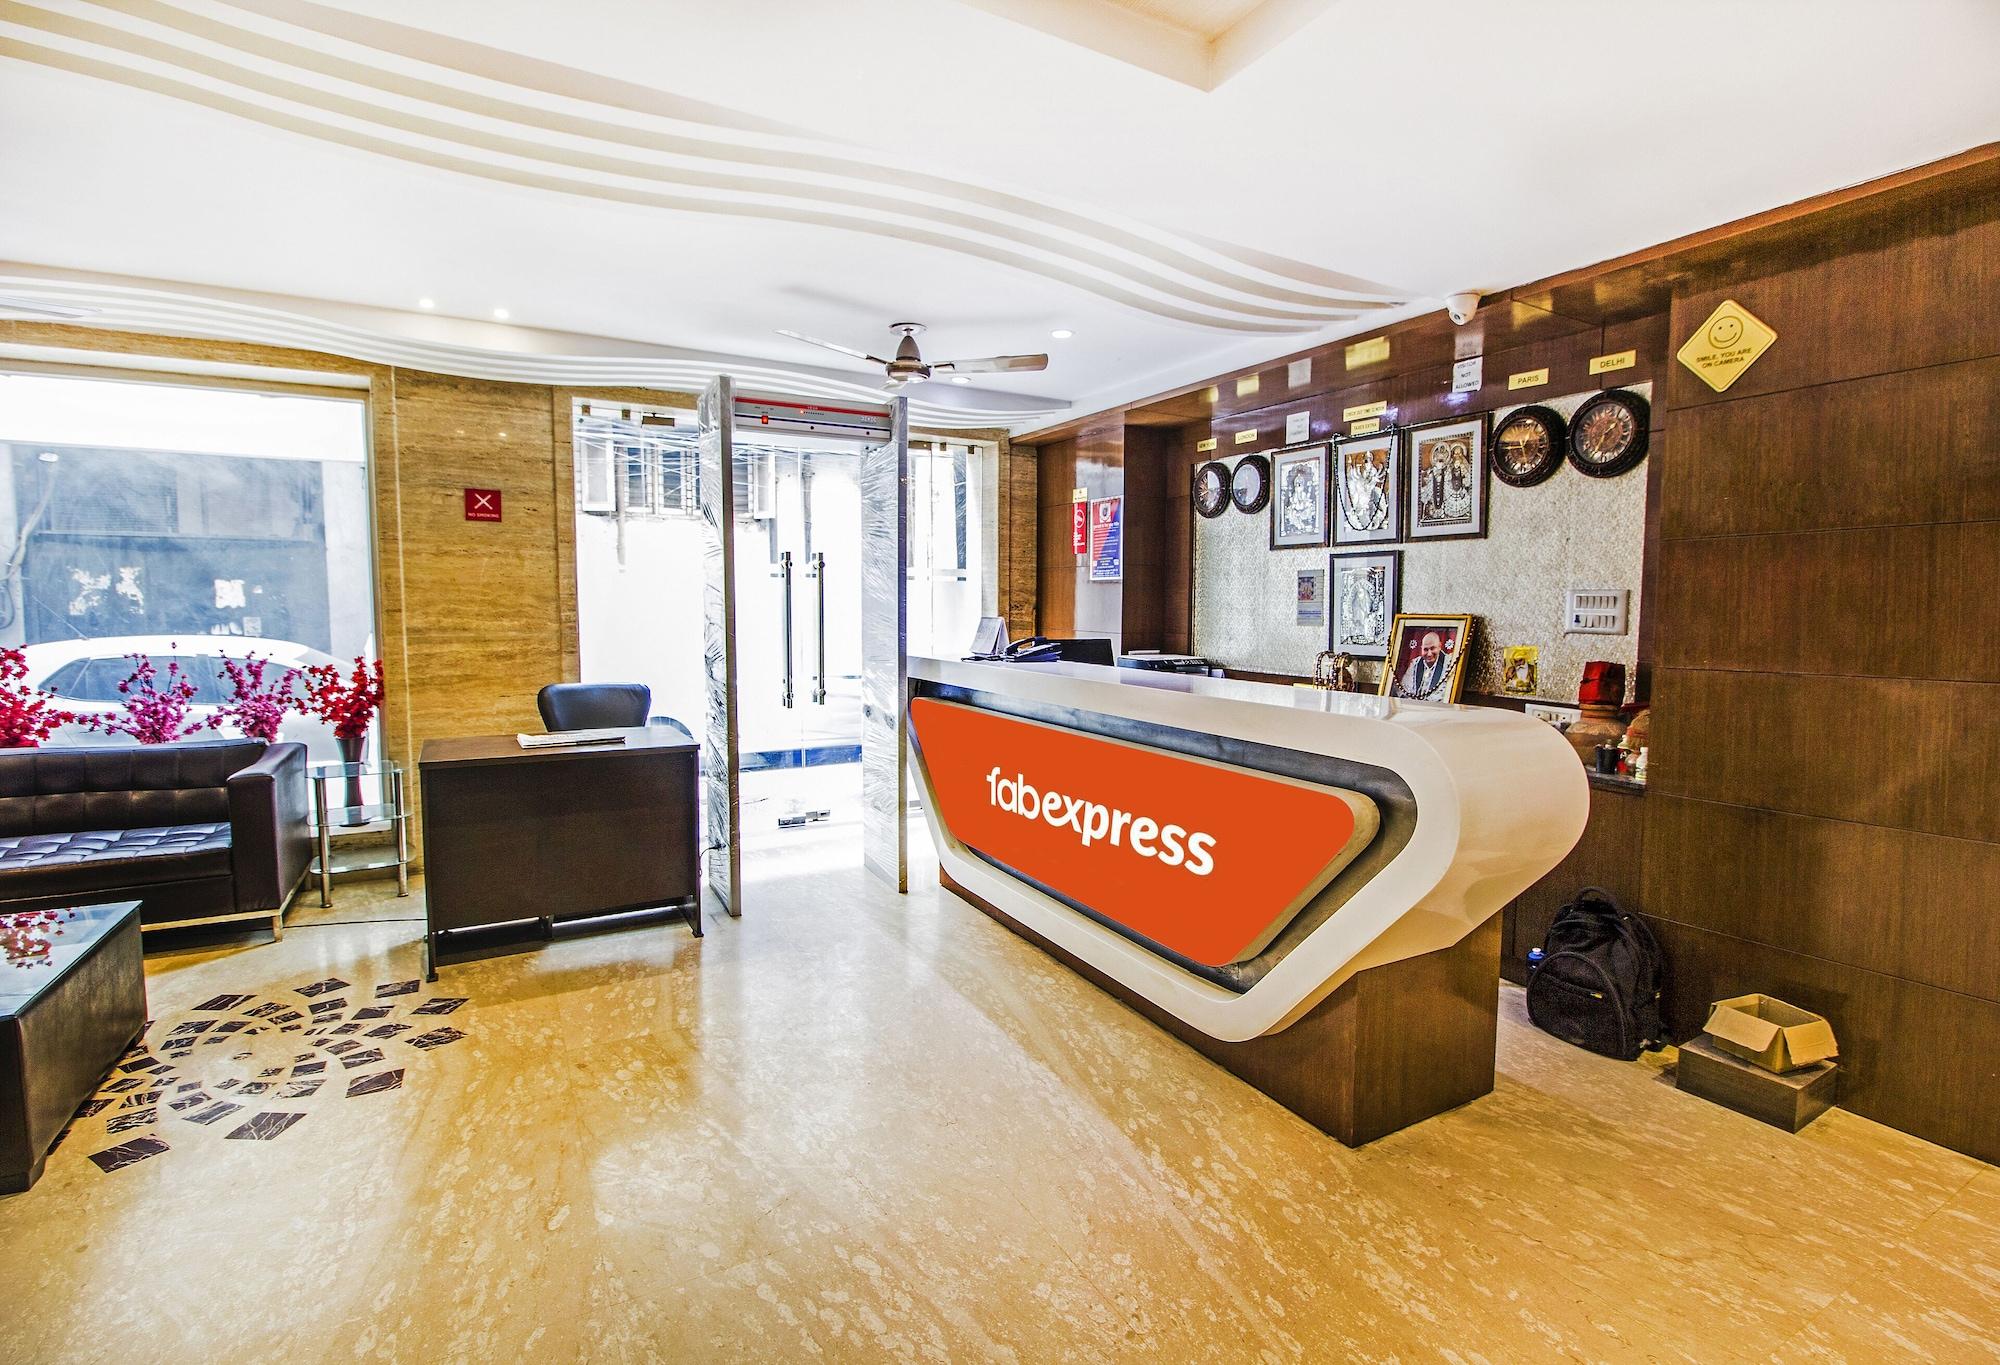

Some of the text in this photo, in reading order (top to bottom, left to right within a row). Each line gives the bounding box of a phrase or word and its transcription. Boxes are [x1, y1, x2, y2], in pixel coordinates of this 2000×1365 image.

[1737, 347, 1752, 355] ARE
[1457, 361, 1476, 369] VISITOR
[1600, 357, 1625, 369] DELHI
[1702, 356, 1745, 369] ON CAMERA
[1517, 375, 1539, 384] PARIS
[1456, 380, 1479, 389] ALLOWED
[986, 766, 1217, 876] fabexpress
